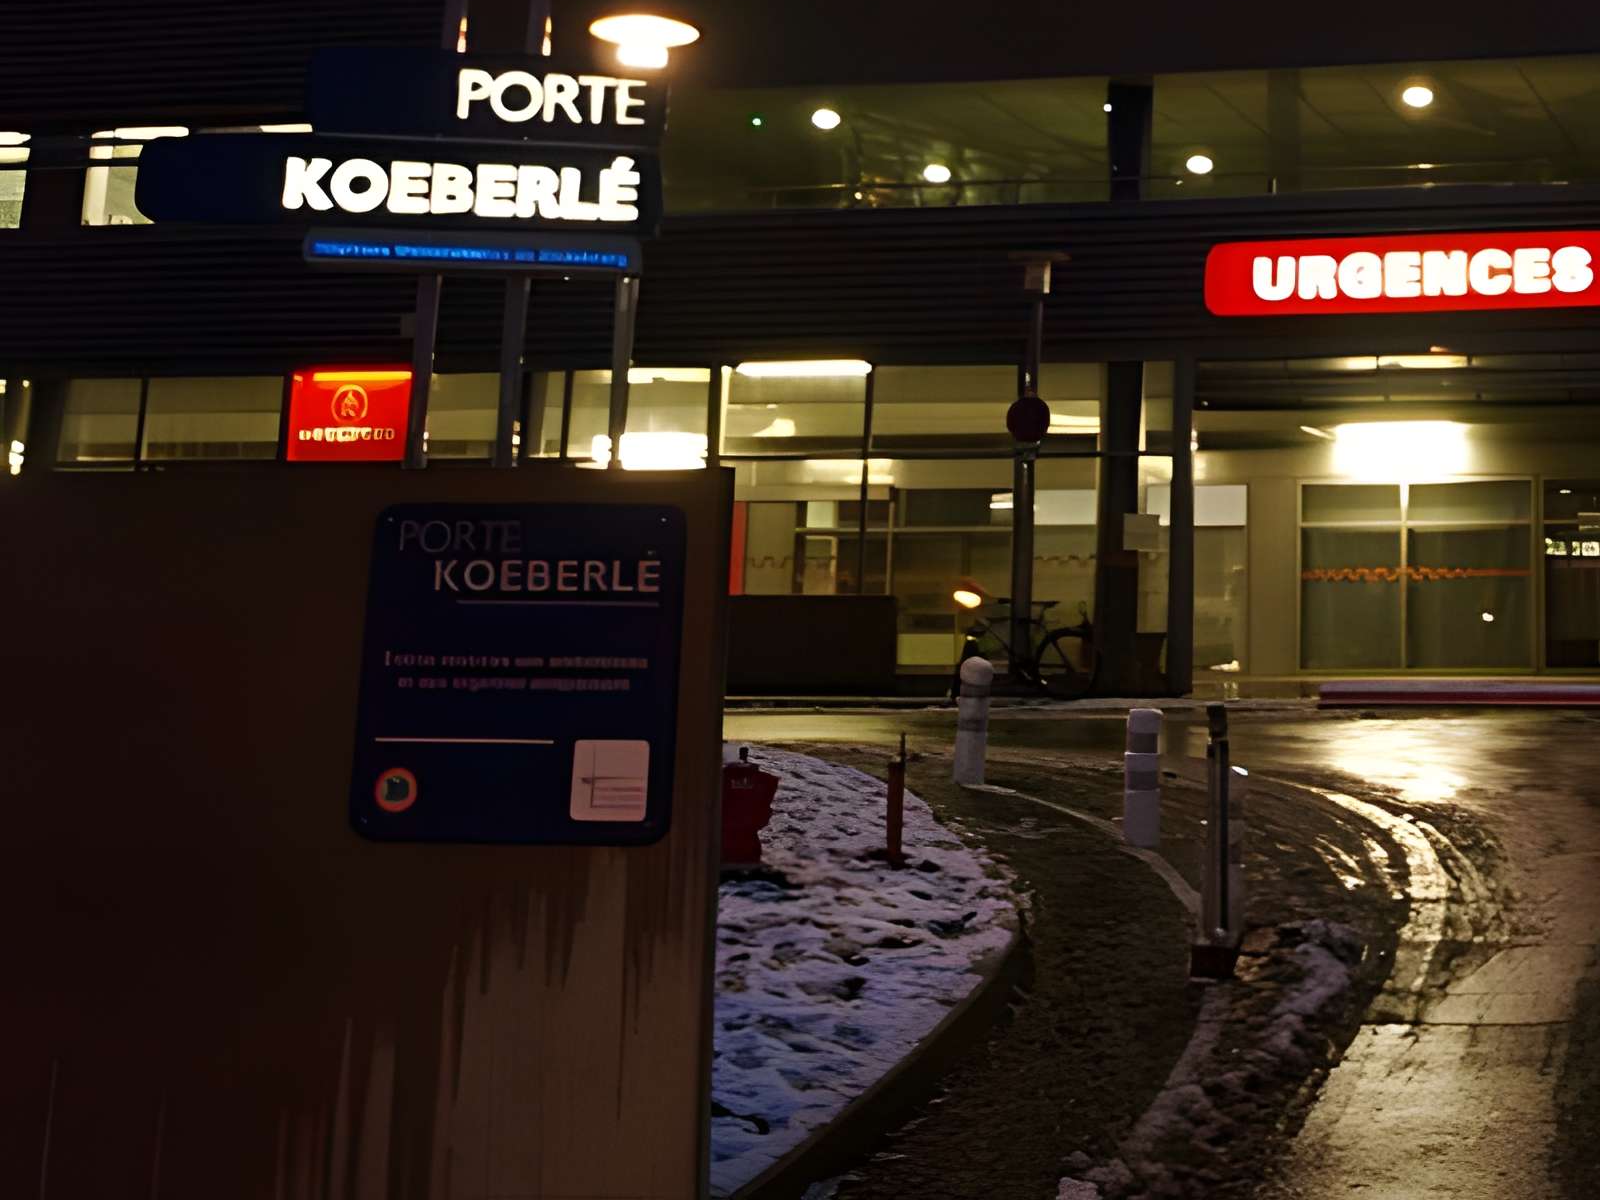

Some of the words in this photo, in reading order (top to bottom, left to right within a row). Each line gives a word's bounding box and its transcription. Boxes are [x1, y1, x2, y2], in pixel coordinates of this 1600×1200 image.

[456, 68, 648, 125] PORTE
[281, 156, 642, 222] KOEBERLÉ
[1252, 246, 1594, 301] URGENCES
[399, 520, 521, 553] PORTE
